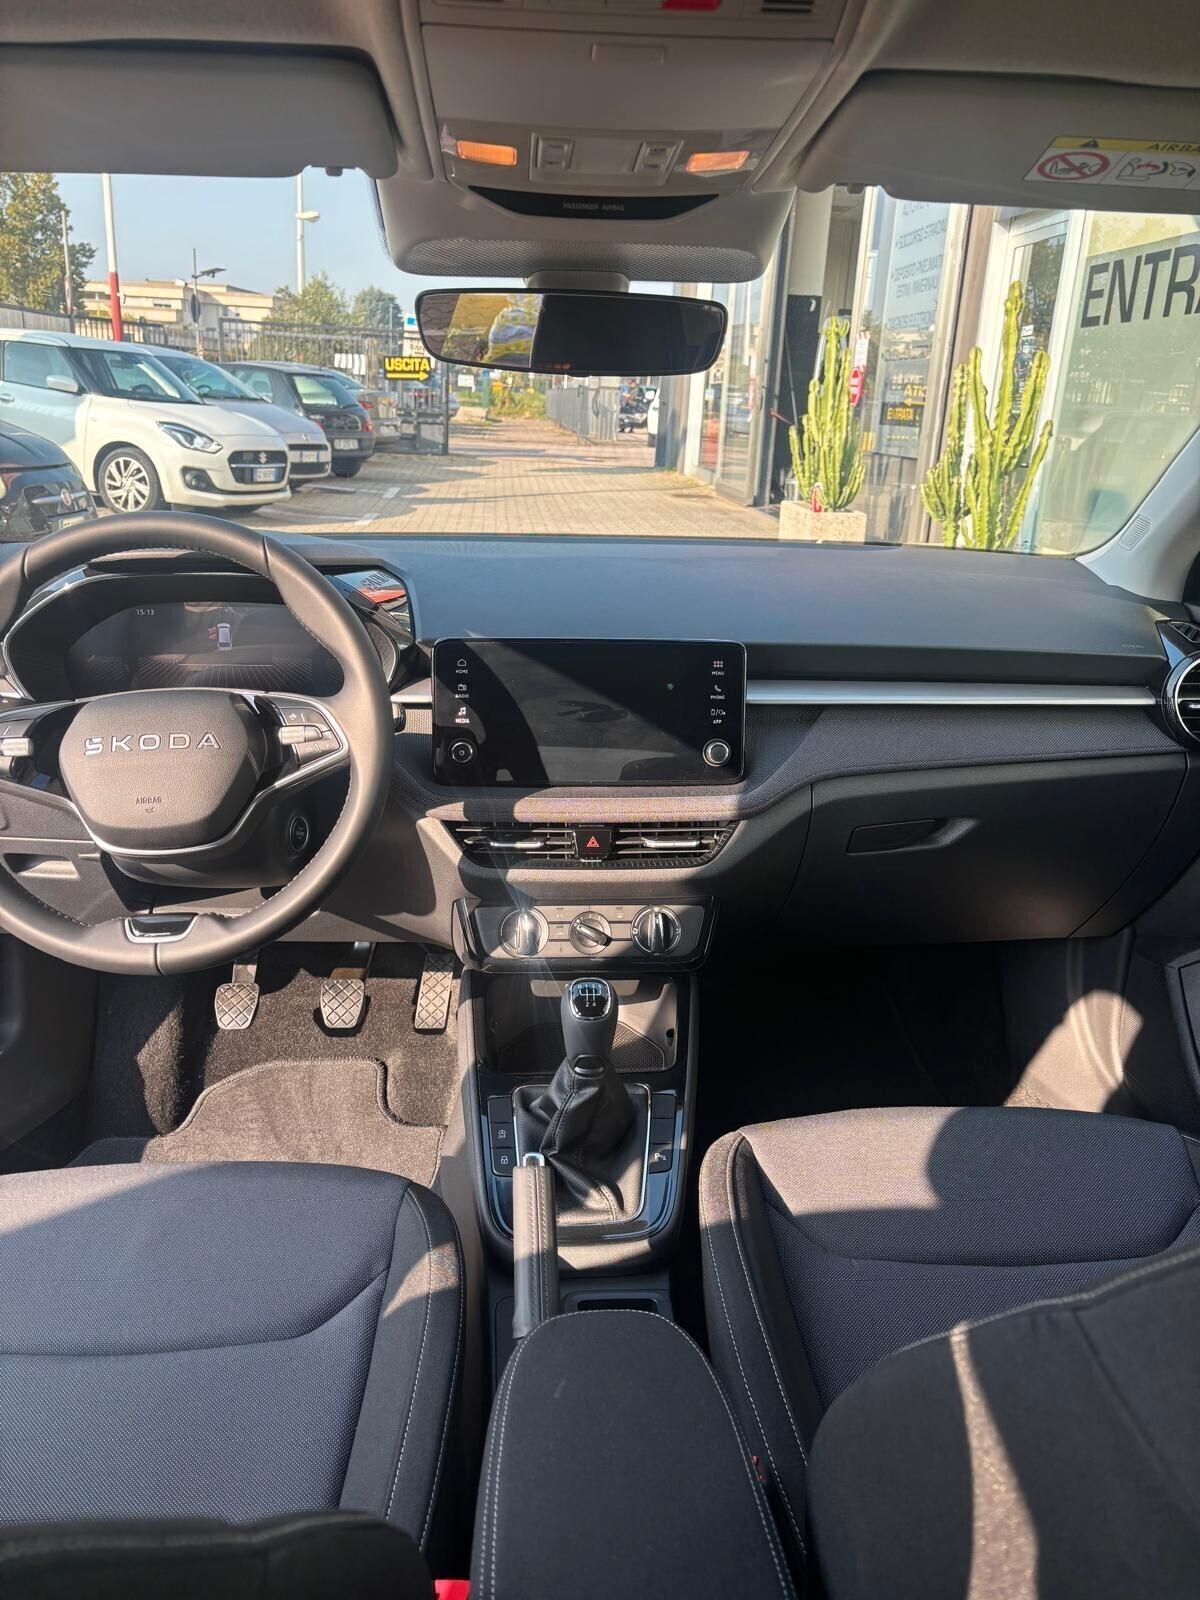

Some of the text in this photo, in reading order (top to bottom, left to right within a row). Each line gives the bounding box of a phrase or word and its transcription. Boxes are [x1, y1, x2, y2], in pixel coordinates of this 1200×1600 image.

[1080, 243, 1200, 328] ENTR
[385, 357, 430, 371] USCITA
[135, 796, 162, 805] AIRBAG
